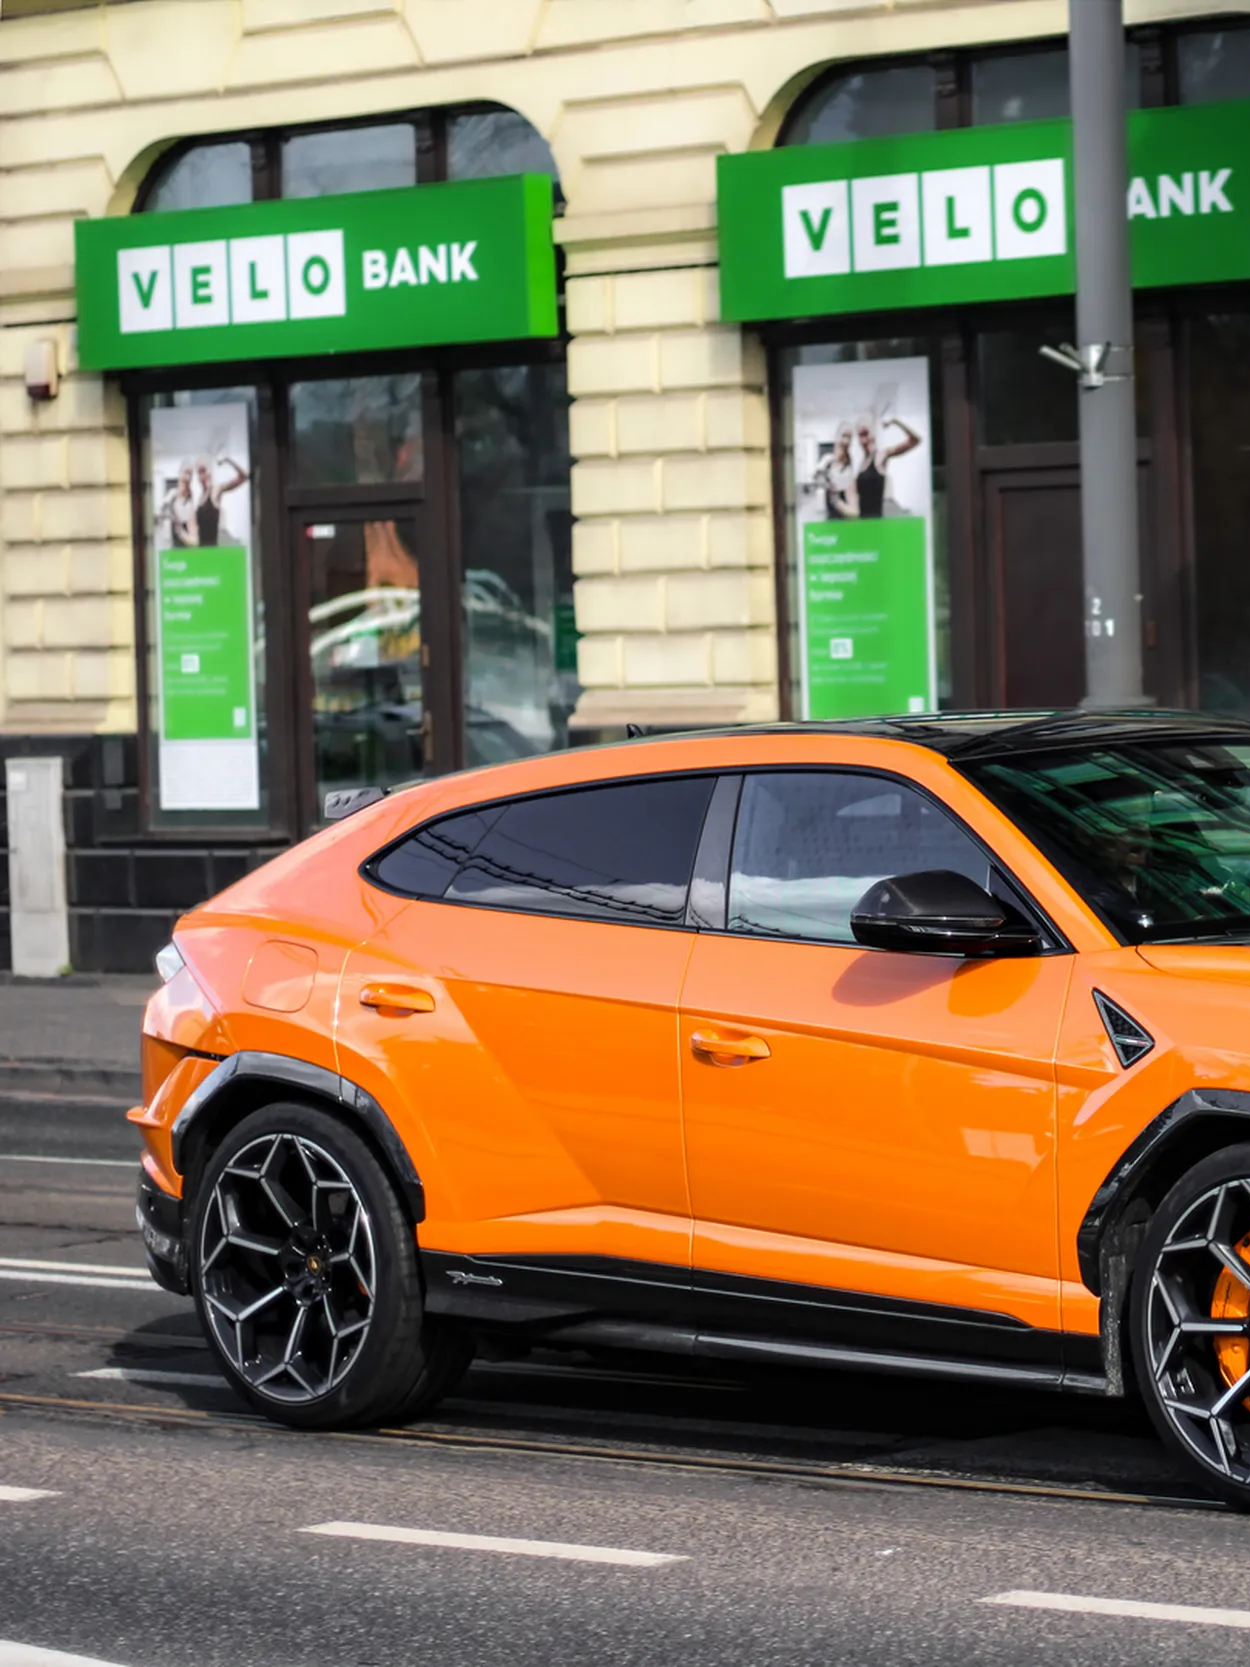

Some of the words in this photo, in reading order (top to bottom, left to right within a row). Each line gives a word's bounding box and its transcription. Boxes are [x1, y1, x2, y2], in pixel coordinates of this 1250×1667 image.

[799, 187, 1048, 252] VELO
[1127, 168, 1234, 220] ANK
[132, 254, 331, 309] VELO
[362, 241, 480, 290] BANK
